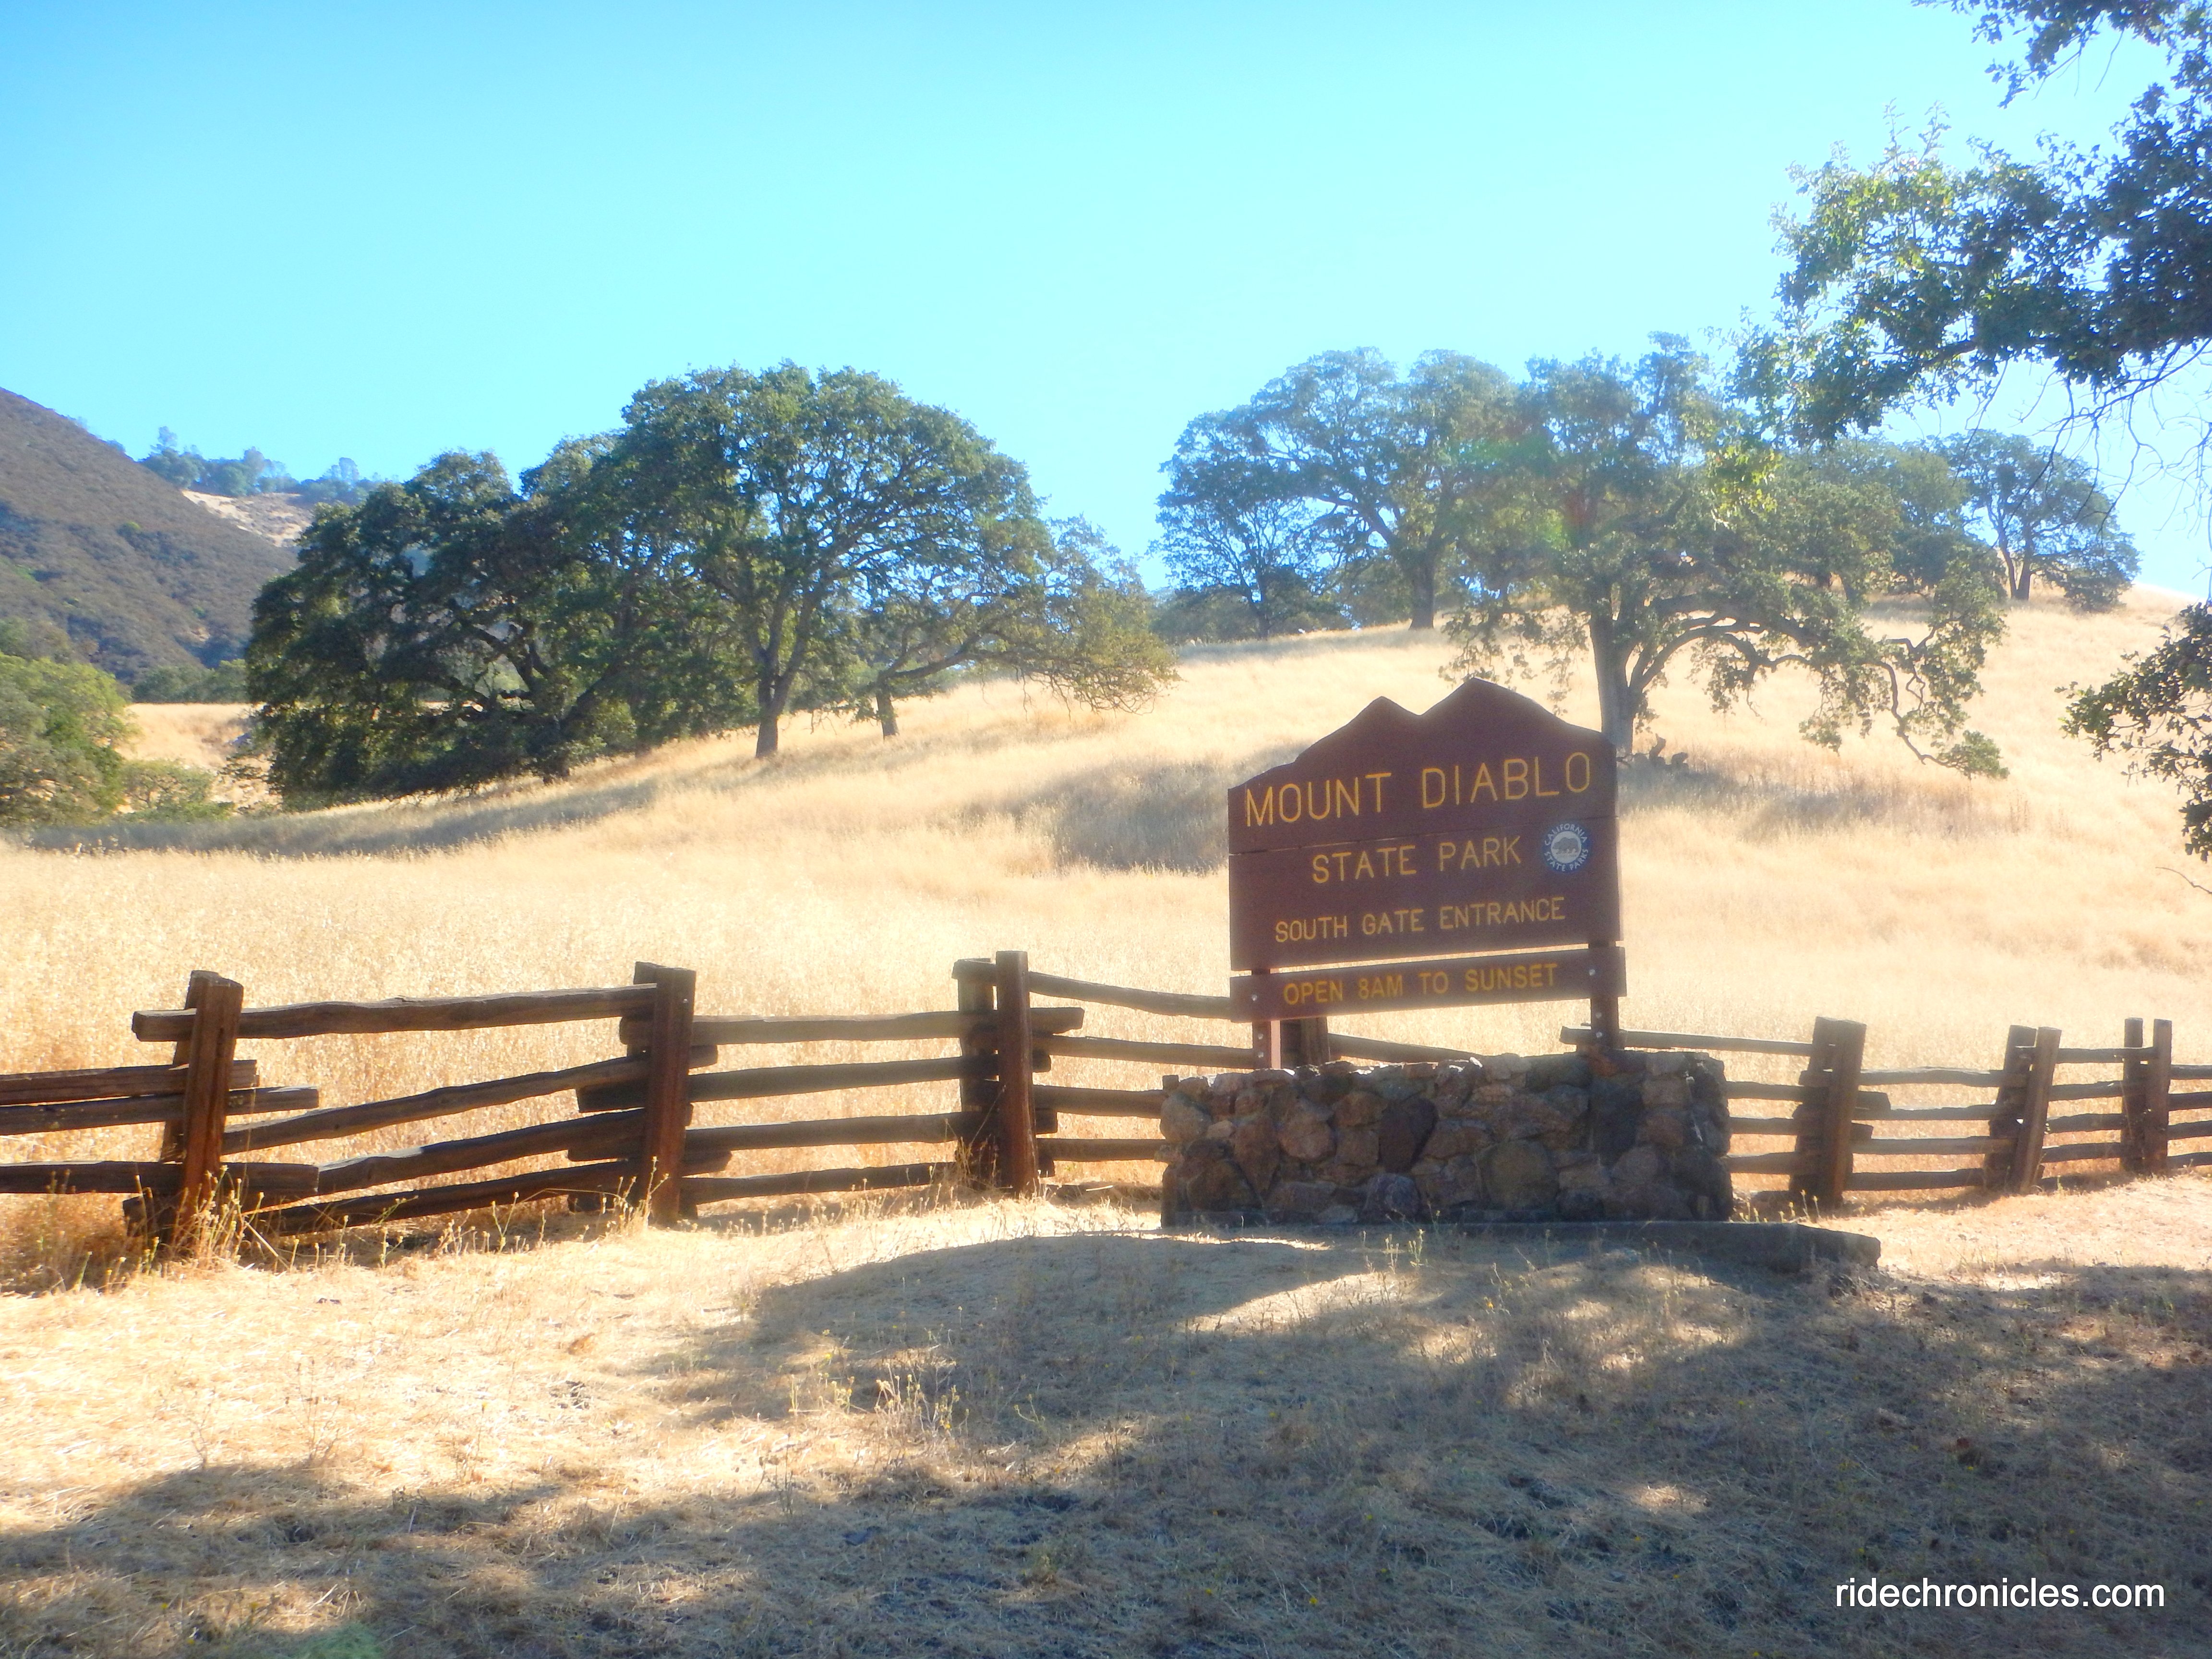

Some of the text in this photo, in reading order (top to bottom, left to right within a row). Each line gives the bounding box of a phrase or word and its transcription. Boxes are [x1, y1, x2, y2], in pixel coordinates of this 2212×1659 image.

[1245, 751, 1591, 827] MOUNT DIABLO
[1544, 823, 1587, 846] CALIFORNIA
[1312, 836, 1522, 884] STATE PARK
[1544, 849, 1588, 872] STATE PARKS
[1274, 896, 1565, 943] SOUTH GATE ENTRANCE
[1283, 963, 1558, 1006] OPEN 8AM TO SUNSET
